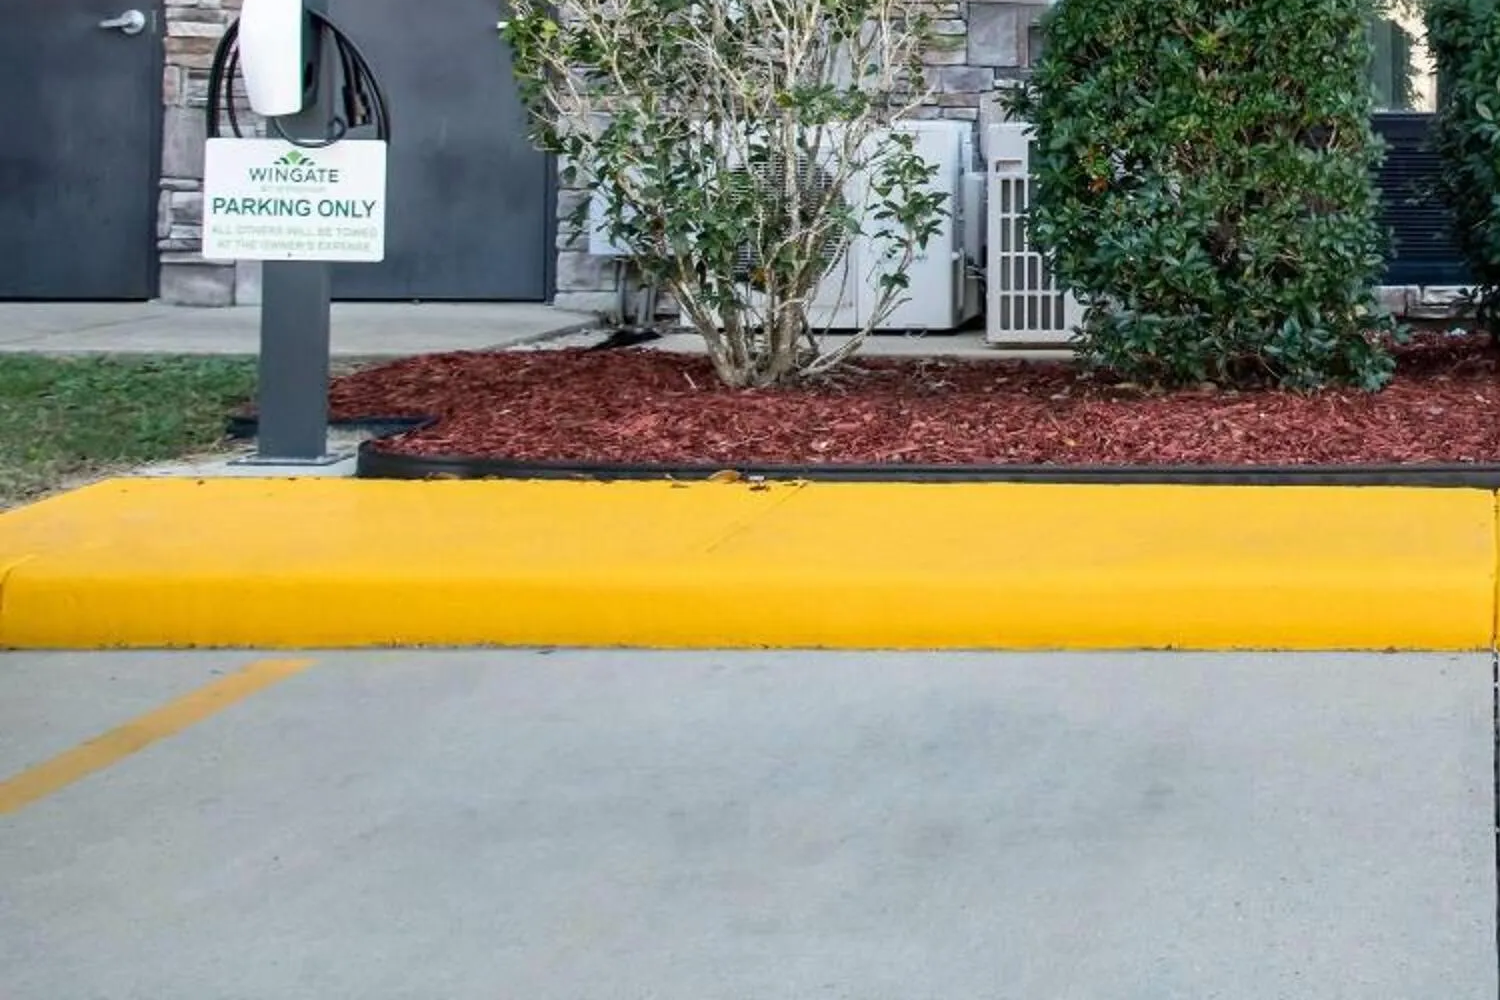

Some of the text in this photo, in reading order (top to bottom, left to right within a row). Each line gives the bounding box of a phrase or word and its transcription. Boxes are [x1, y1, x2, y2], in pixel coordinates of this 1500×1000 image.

[249, 168, 339, 183] WINGATE
[212, 197, 377, 218] PARKING ONLY
